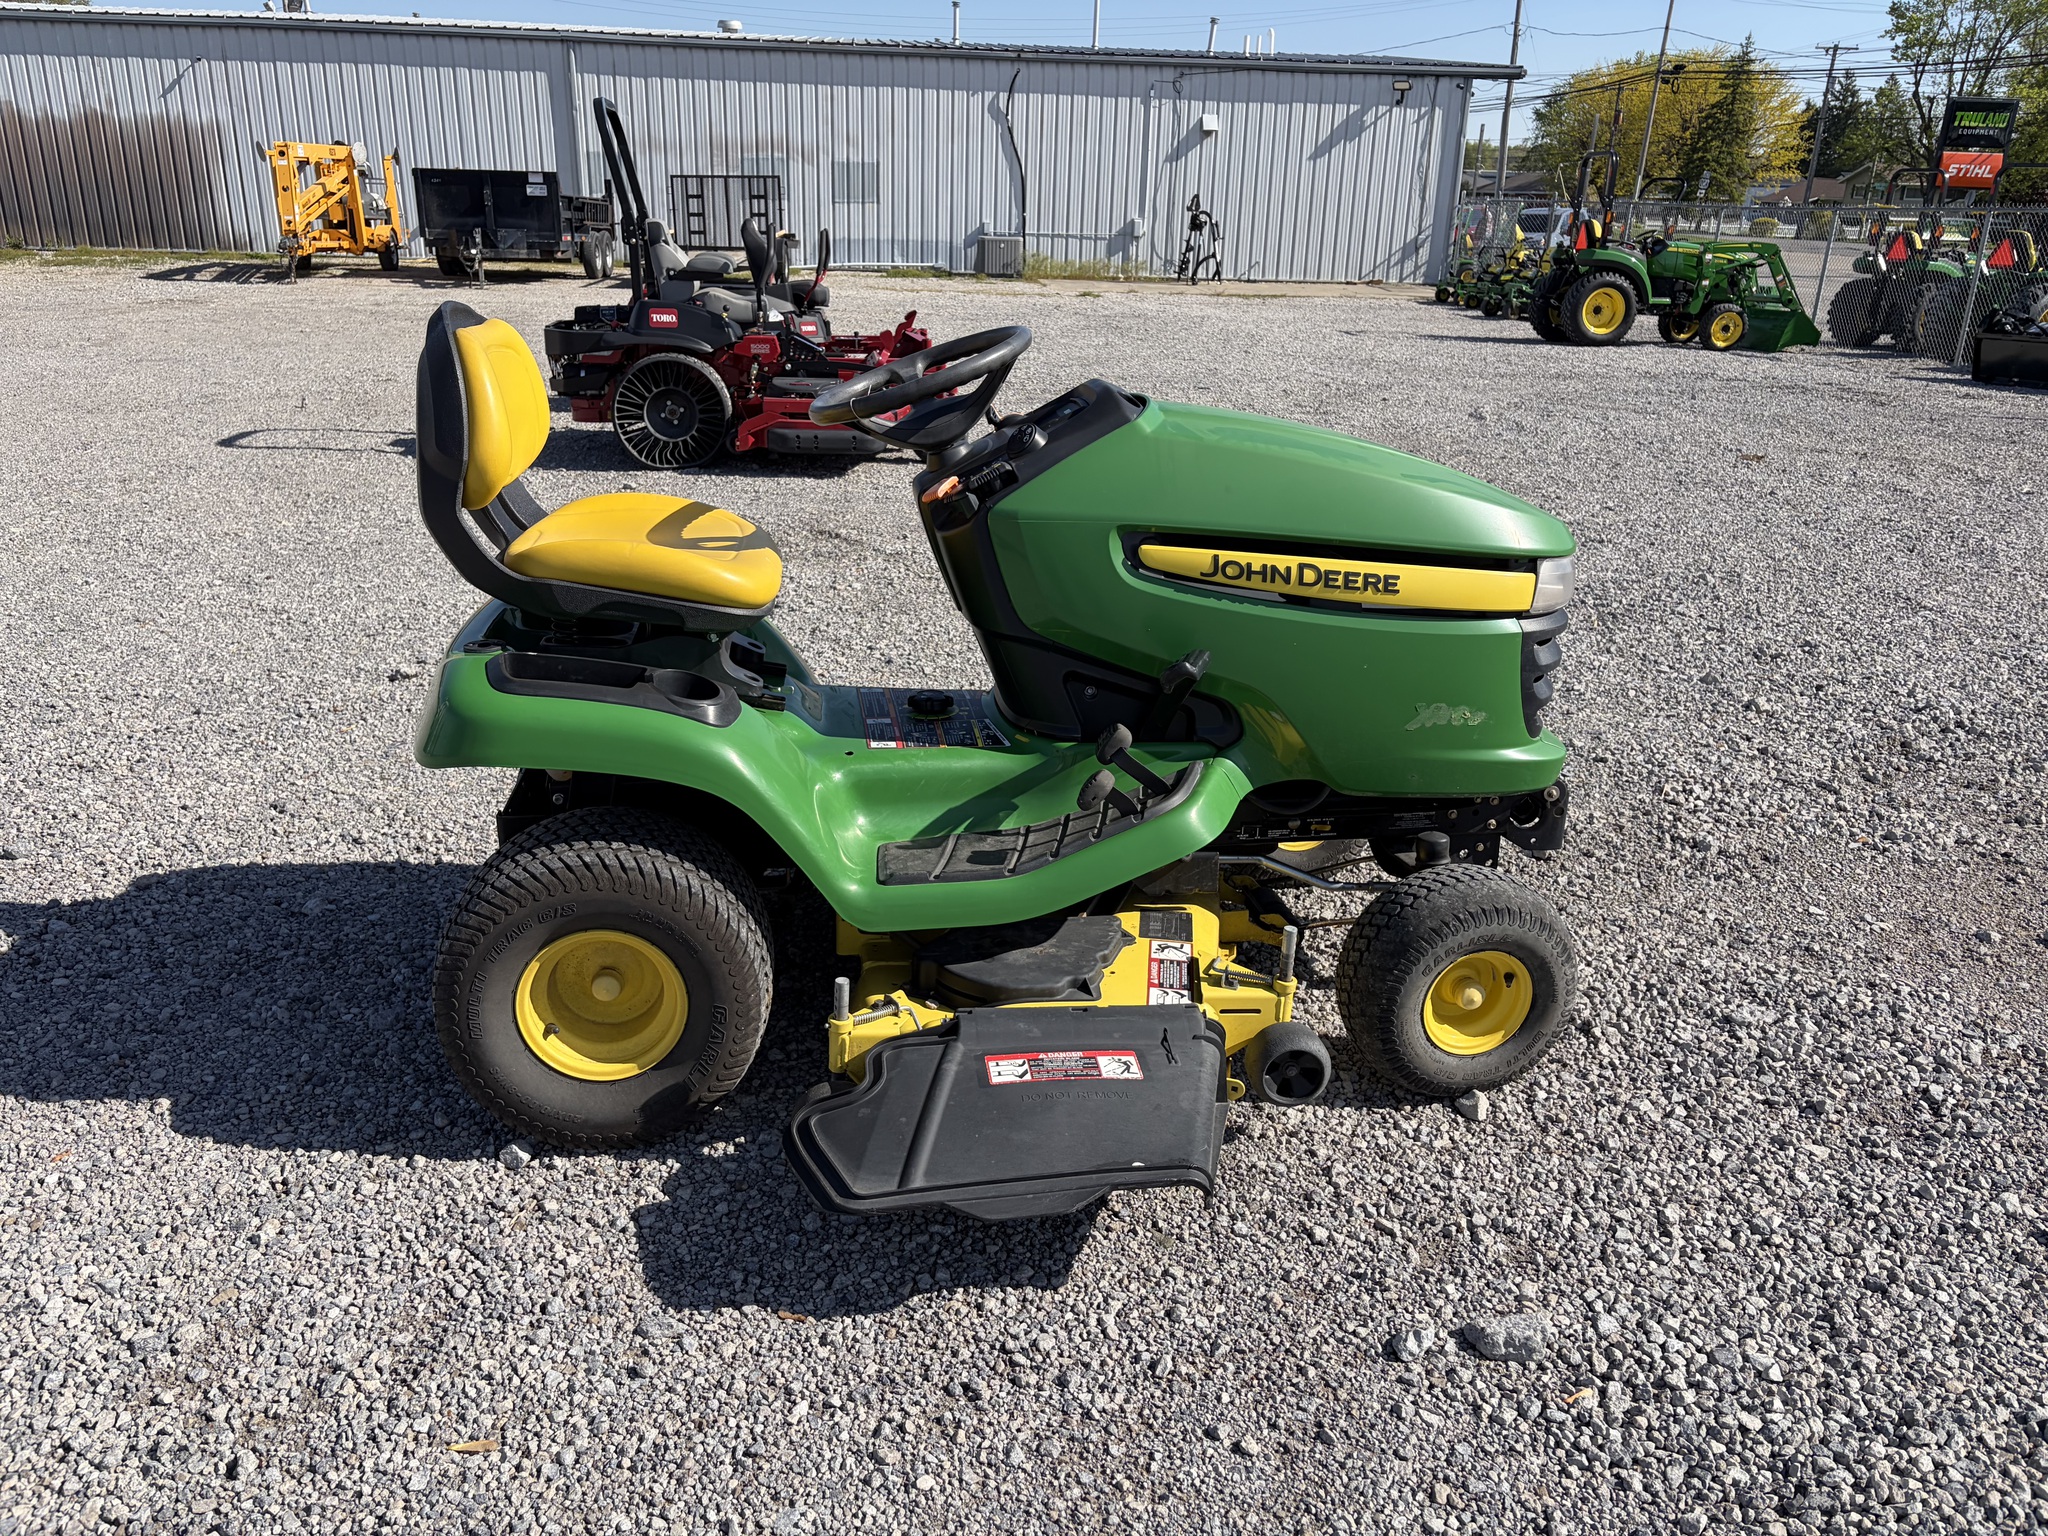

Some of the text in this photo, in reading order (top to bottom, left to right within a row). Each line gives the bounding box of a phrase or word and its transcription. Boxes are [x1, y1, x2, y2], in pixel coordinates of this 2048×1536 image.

[1954, 111, 2010, 128] TRULAND
[1958, 128, 1999, 136] EQUIPMENT
[1948, 164, 1994, 178] STIHL
[651, 313, 677, 322] TORO
[1200, 554, 1401, 595] JOHN DEERE
[483, 918, 534, 963] TRAC
[1150, 961, 1159, 979] DANGER
[1020, 1091, 1133, 1102] DO NOT REMOVE
